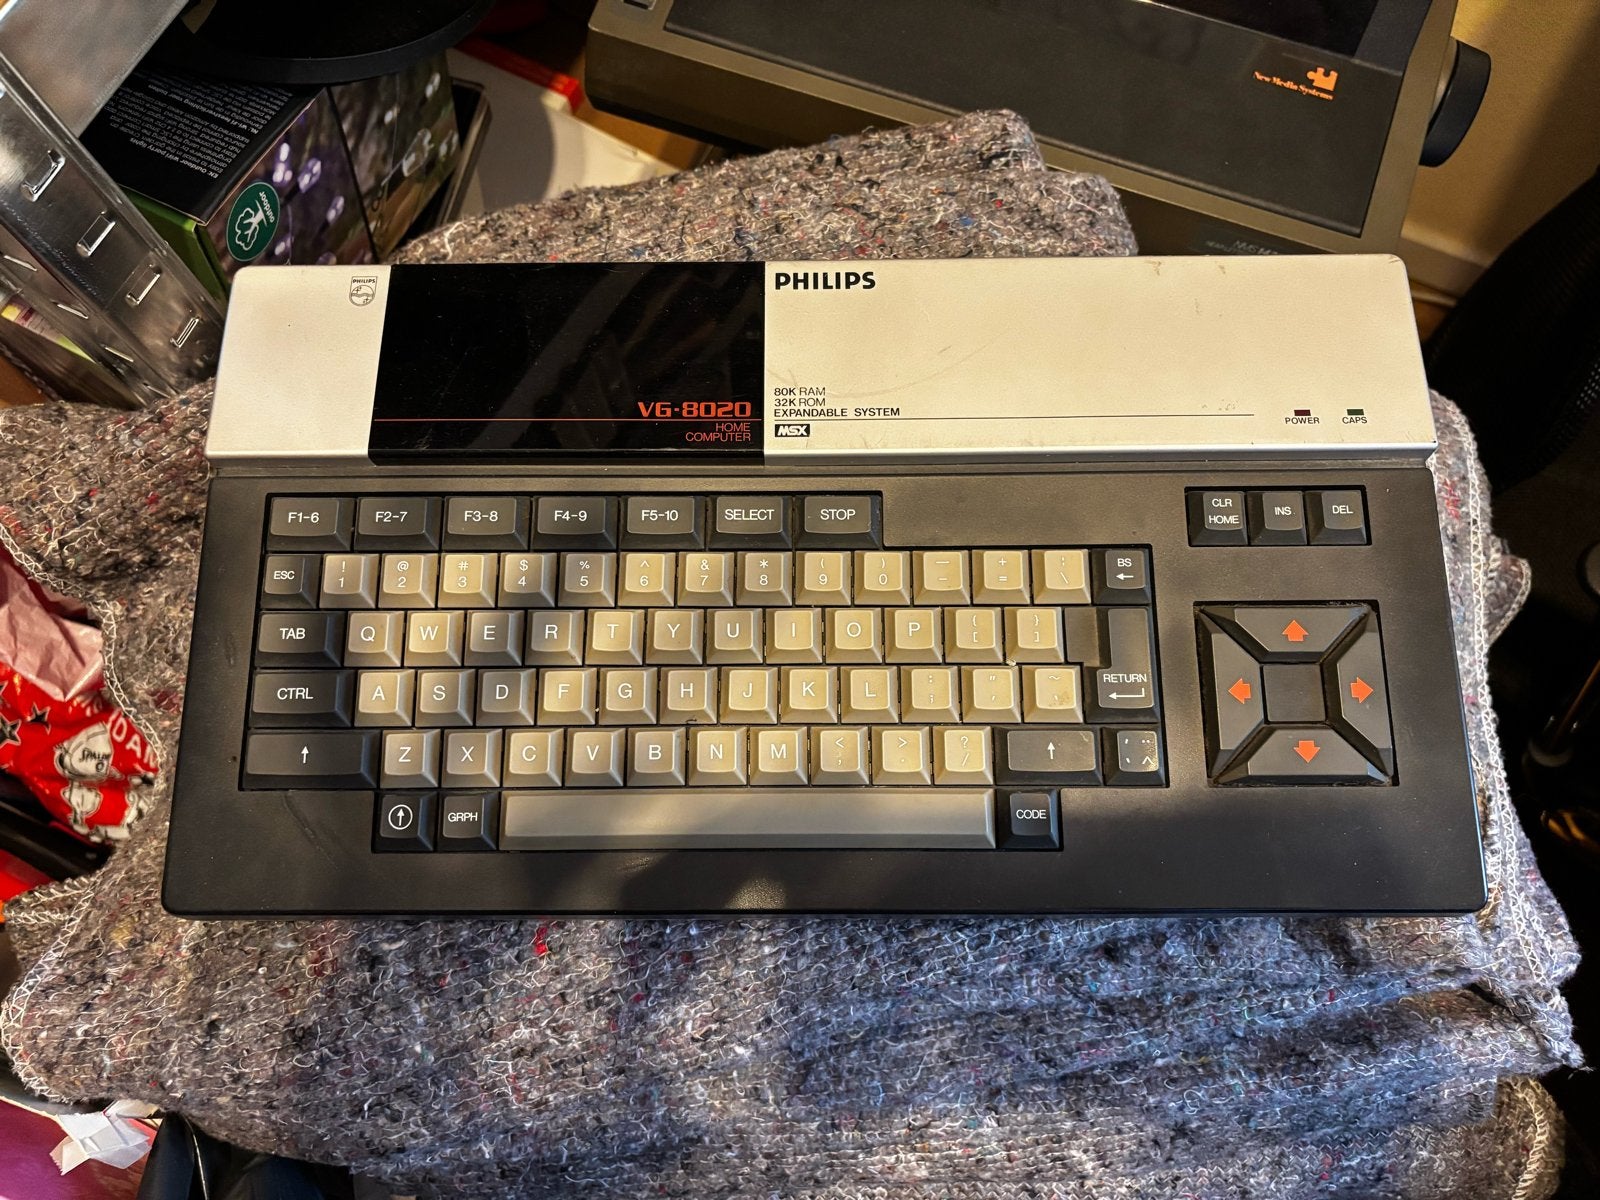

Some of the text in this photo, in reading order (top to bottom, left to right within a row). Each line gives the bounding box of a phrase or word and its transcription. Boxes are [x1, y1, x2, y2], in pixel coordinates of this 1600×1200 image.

[1254, 71, 1333, 101] New Media Systems
[258, 190, 277, 224] outdoor
[775, 271, 876, 290] PHILIPS
[774, 387, 826, 396] 80K RAM
[774, 398, 826, 407] 32K ROM
[638, 401, 751, 418] VG-8020
[774, 408, 900, 417] EXPANDABLE SYSTEM
[1285, 416, 1320, 425] POWER
[1342, 416, 1368, 425] CAPS
[716, 423, 751, 432] HOME
[777, 425, 808, 436] MSX
[685, 432, 751, 442] COMPUTER
[1211, 498, 1232, 508] CLR
[641, 509, 679, 521] F5-10
[724, 509, 775, 521] SELECT
[820, 508, 856, 521] STOP
[1275, 507, 1292, 516] INS
[1332, 505, 1353, 514] DEL
[288, 512, 320, 523] F1-6
[375, 511, 408, 523] F2-7
[464, 510, 498, 522] F3-8
[554, 510, 587, 522] F4-9
[1209, 515, 1240, 524] HOME
[397, 560, 409, 572] @
[458, 560, 469, 571] #
[519, 559, 529, 572] $
[579, 560, 590, 570] %
[700, 559, 710, 571] &
[999, 557, 1007, 566] +
[1117, 558, 1132, 567] BS
[273, 570, 295, 580] ESC
[580, 575, 588, 587] 5
[639, 575, 649, 587] 6
[700, 575, 708, 586] 7
[759, 574, 768, 586] 8
[818, 574, 828, 585] 9
[339, 577, 344, 588] 1
[399, 576, 407, 588] 2
[458, 576, 467, 588] 3
[518, 576, 527, 587] 4
[280, 628, 306, 640] TAB
[360, 626, 376, 642] Q
[420, 625, 439, 641] W
[483, 625, 495, 640] E
[545, 625, 558, 640] R
[607, 624, 619, 639] T
[667, 623, 681, 638] Y
[727, 623, 740, 638] U
[846, 622, 862, 638] O
[908, 622, 921, 637] P
[1103, 673, 1147, 683] RETURN
[277, 687, 314, 700] CTRL
[371, 685, 386, 701] A
[432, 685, 446, 701] S
[495, 684, 509, 700] D
[558, 683, 570, 699] F
[617, 683, 633, 699] G
[680, 682, 694, 698] H
[742, 682, 753, 698] J
[802, 681, 816, 697] K
[865, 681, 877, 697] L
[834, 736, 844, 748] <
[898, 736, 908, 748] >
[960, 736, 968, 748] ?
[398, 747, 412, 763] Z
[460, 746, 475, 762] X
[522, 745, 537, 762] C
[586, 745, 600, 761] V
[648, 744, 662, 760] B
[710, 744, 723, 760] N
[770, 743, 787, 759] M
[961, 753, 970, 767] /
[447, 812, 478, 823] GRPH
[1016, 809, 1047, 820] CODE
